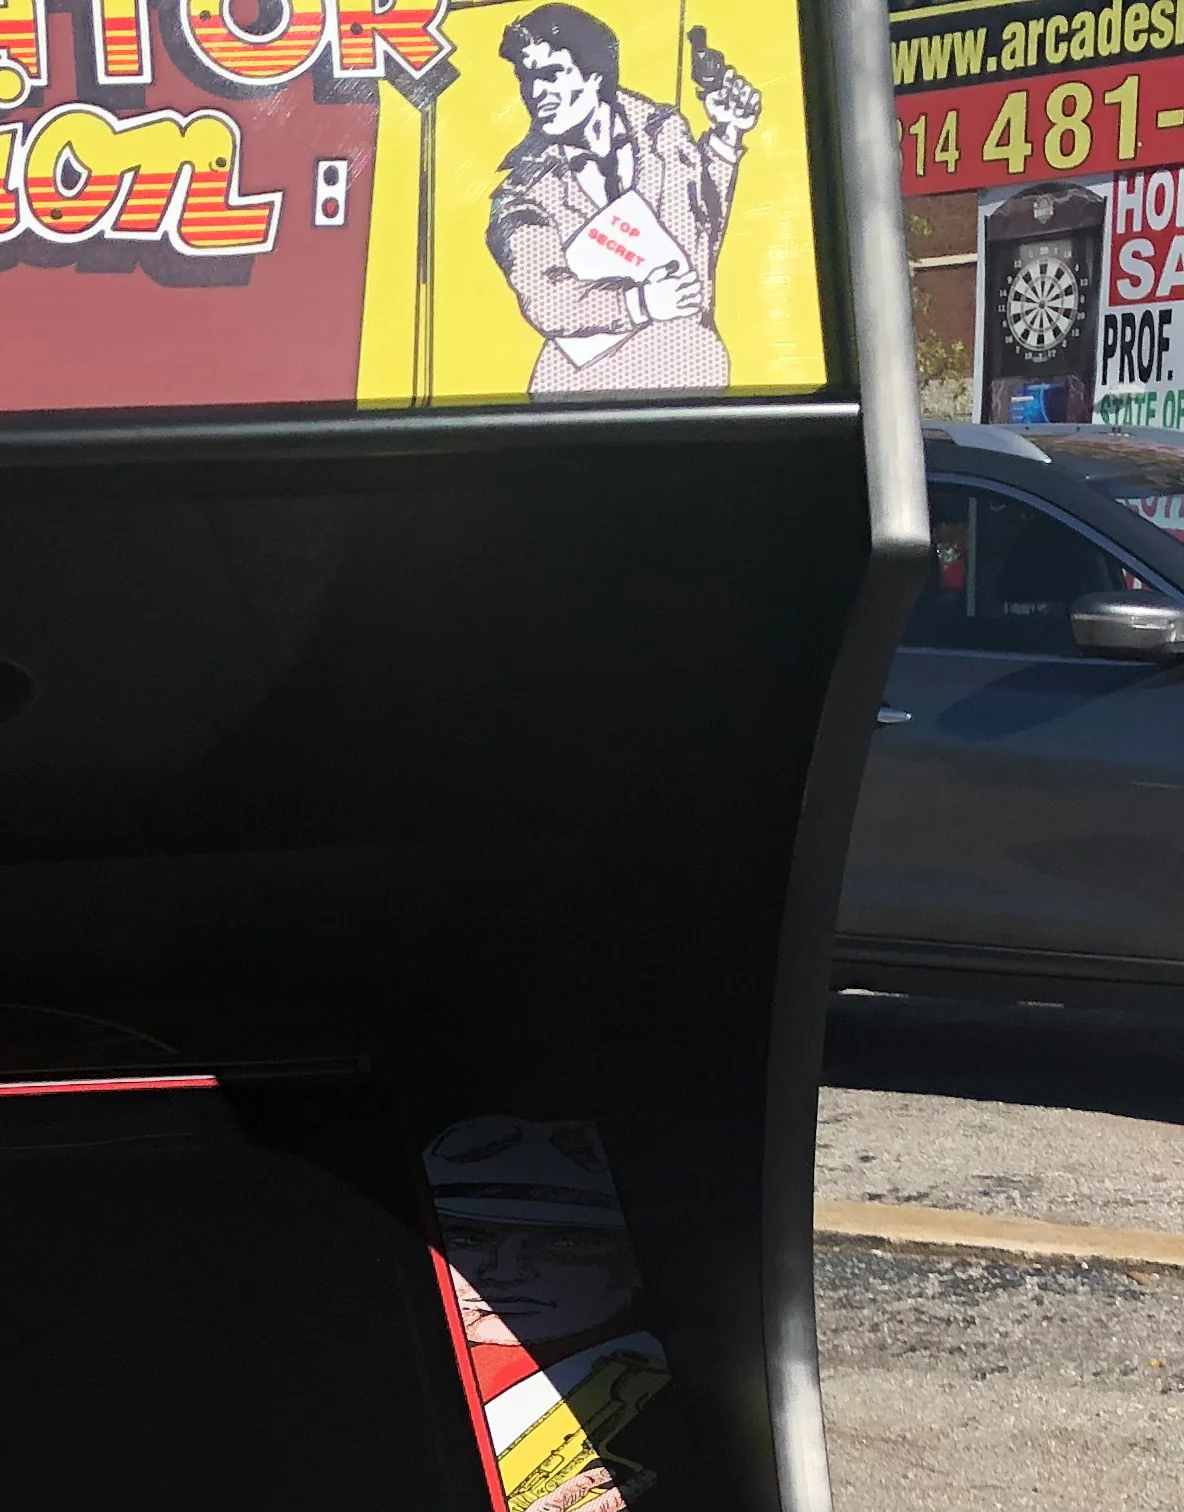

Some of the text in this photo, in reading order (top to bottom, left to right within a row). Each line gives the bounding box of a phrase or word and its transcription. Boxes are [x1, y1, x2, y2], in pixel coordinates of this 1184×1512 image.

[897, 108, 960, 177] 14
[588, 228, 645, 267] SECRET
[610, 215, 641, 237] TOP
[1101, 309, 1173, 385] PROF.
